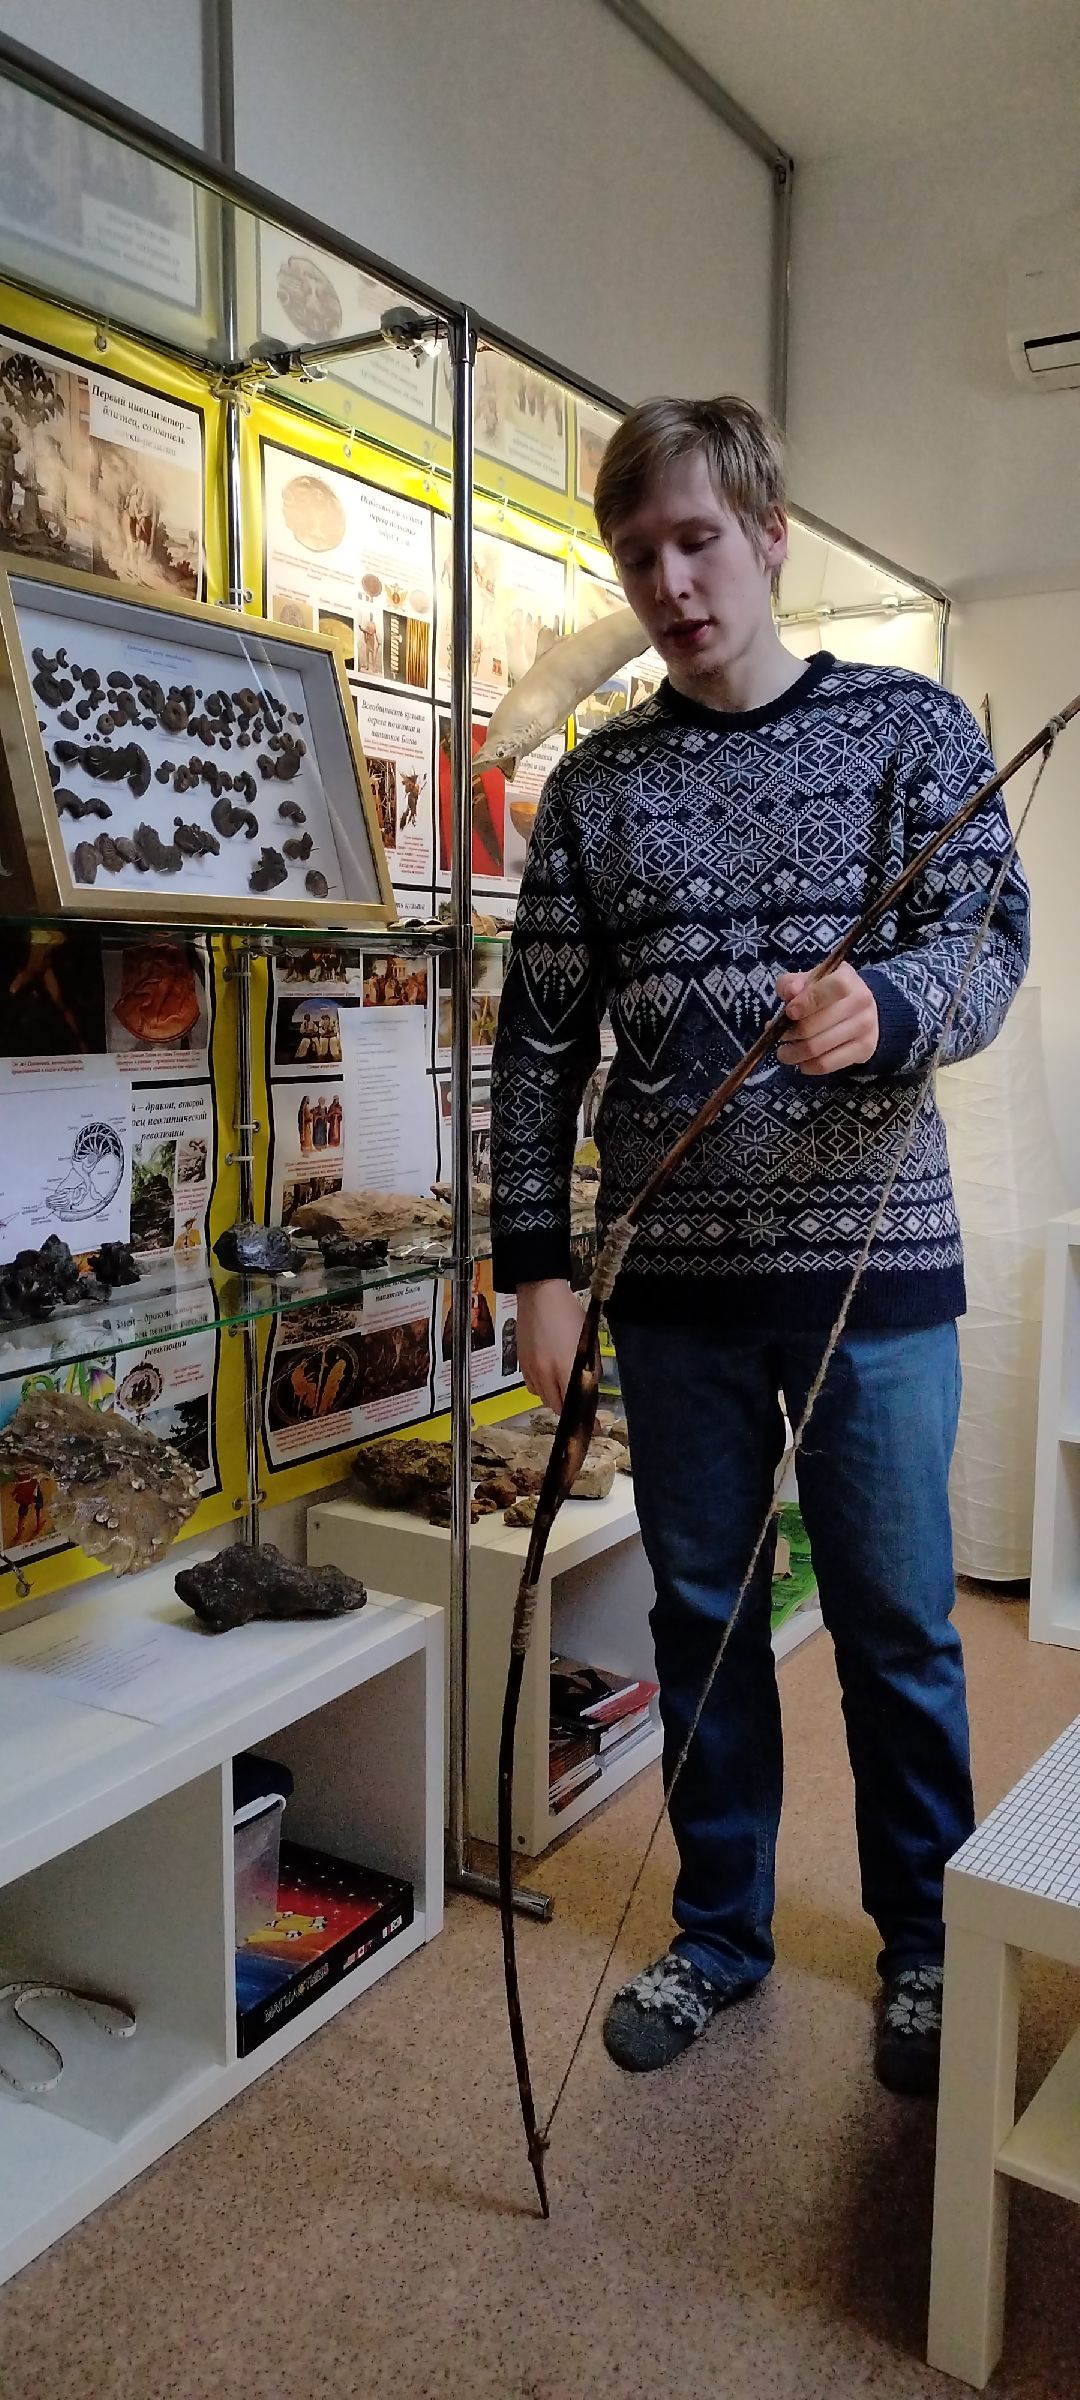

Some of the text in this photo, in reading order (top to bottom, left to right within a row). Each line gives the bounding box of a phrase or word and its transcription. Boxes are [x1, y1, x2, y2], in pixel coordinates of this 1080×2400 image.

[92, 384, 126, 406] Первый
[145, 1101, 176, 1114] дракон,
[147, 1110, 208, 1126] неолитической
[140, 1130, 185, 1143] революции
[144, 1309, 174, 1324] дракон,
[144, 1340, 187, 1359] революции
